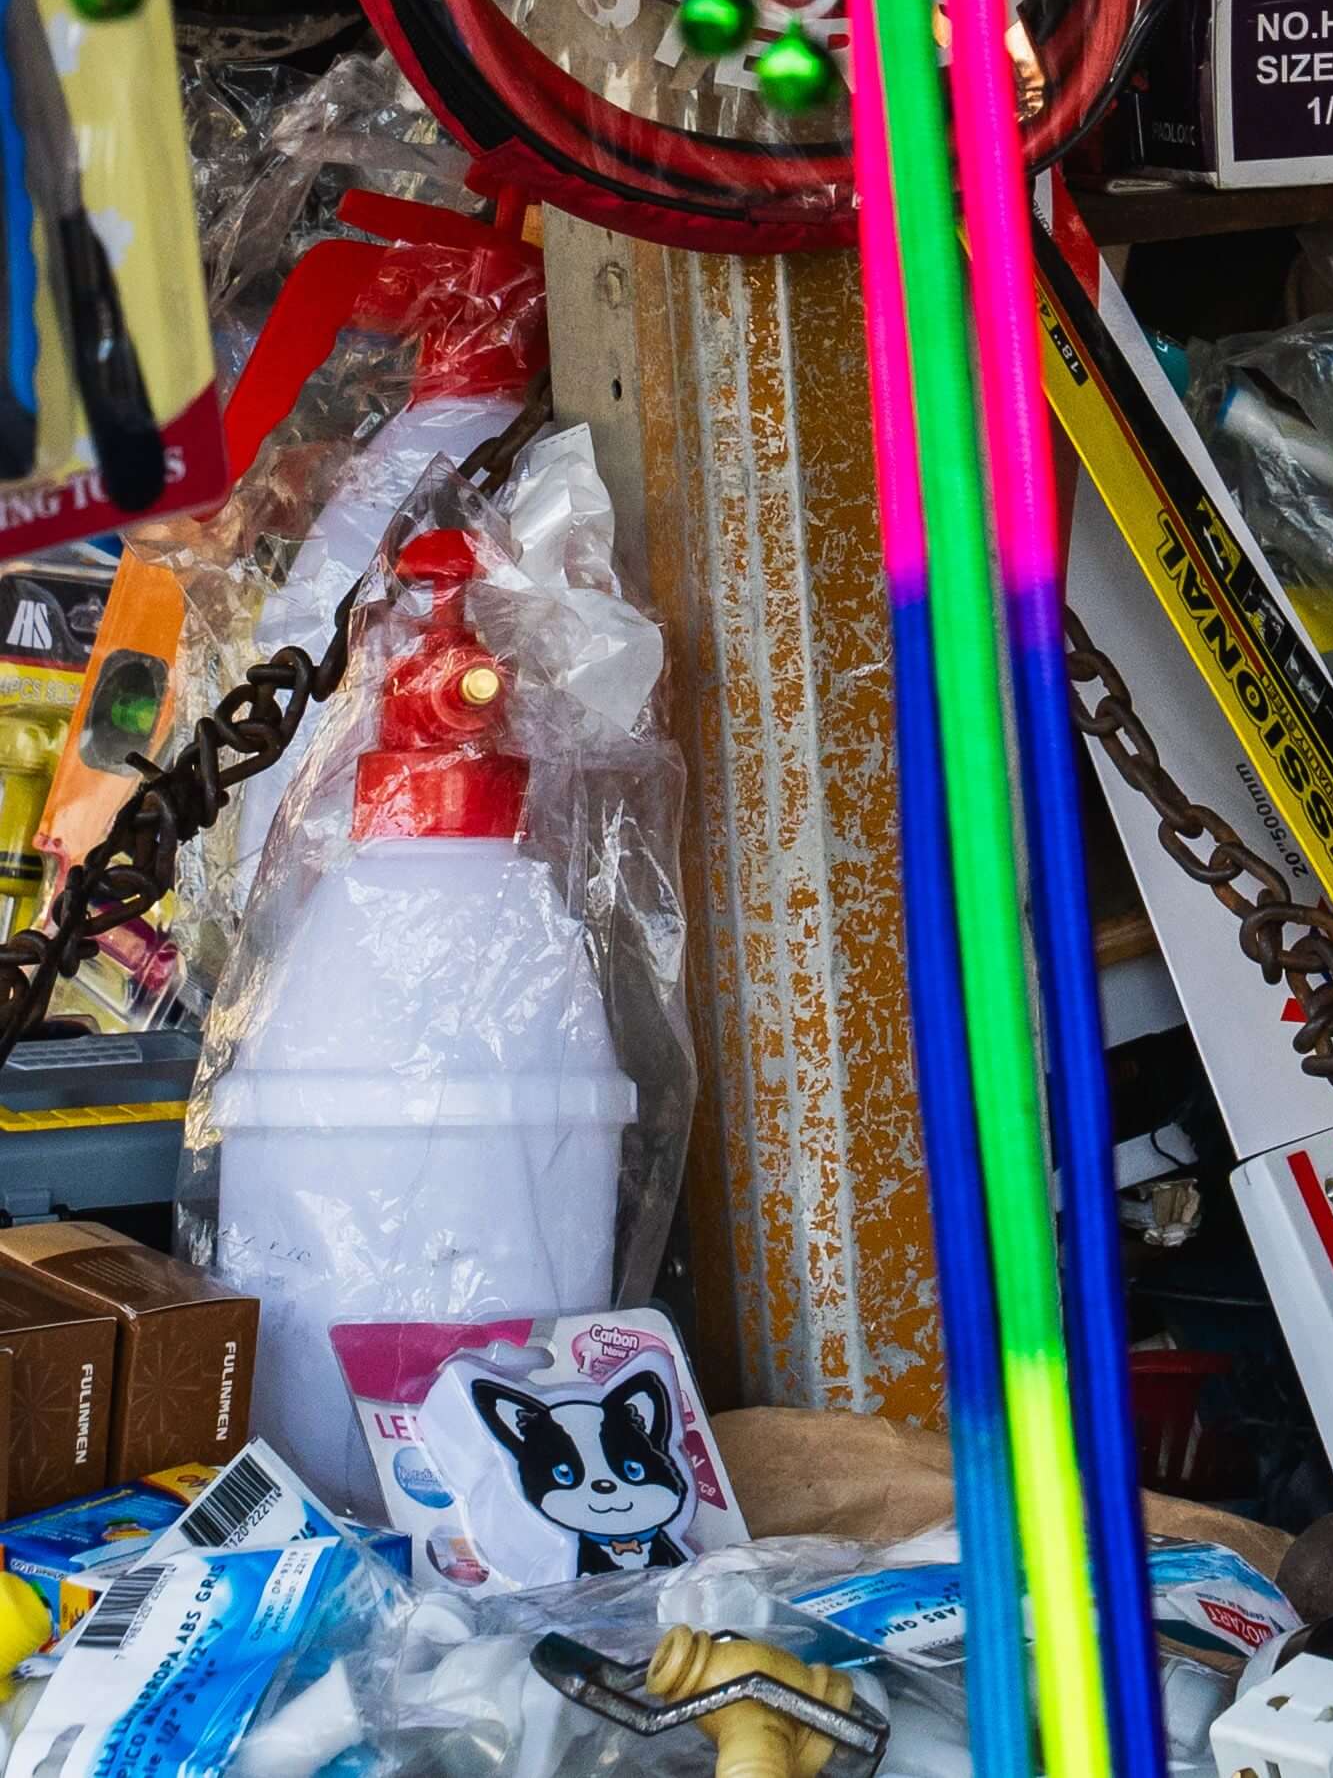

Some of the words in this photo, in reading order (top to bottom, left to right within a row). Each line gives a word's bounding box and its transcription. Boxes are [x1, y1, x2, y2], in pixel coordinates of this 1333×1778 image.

[589, 1324, 639, 1351] Carbon
[75, 1362, 94, 1466] FULINMEN
[215, 1340, 238, 1442] FULINMEN
[180, 1609, 203, 1647] ABS
[197, 1562, 228, 1604] GRIS
